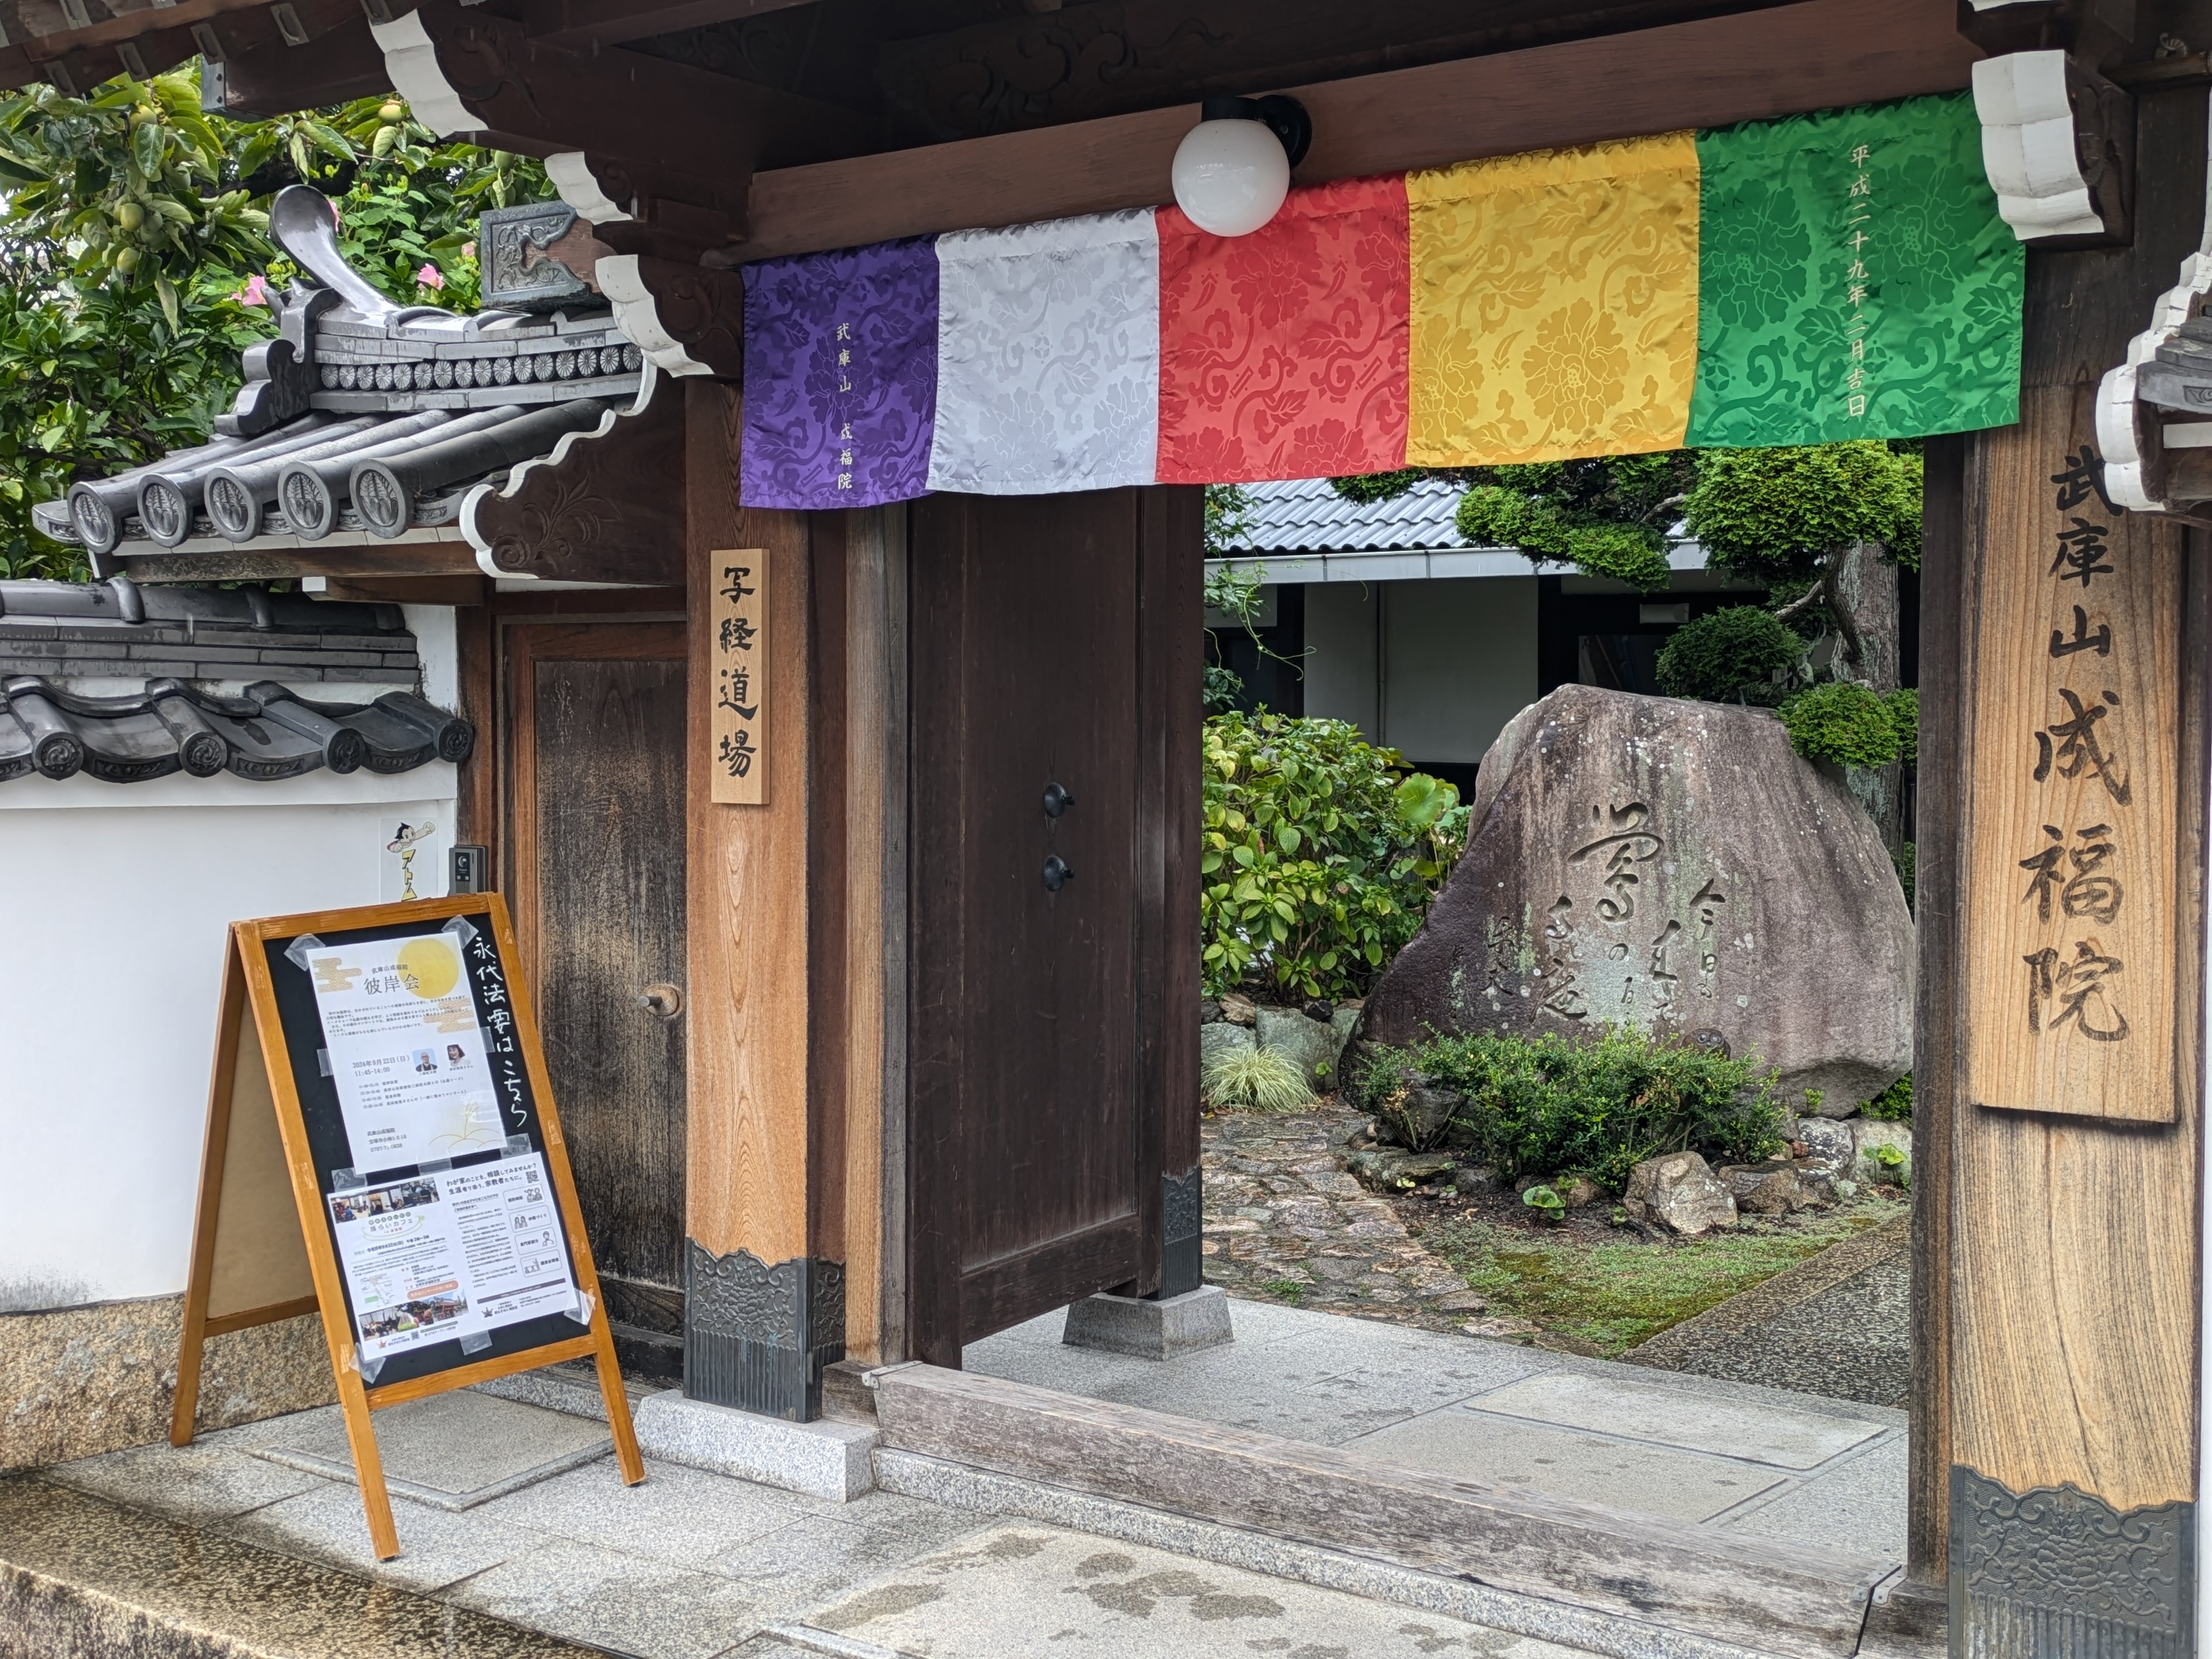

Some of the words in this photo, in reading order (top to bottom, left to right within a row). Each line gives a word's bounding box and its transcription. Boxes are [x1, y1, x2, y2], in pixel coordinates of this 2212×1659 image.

[1847, 144, 1871, 417] 平成二十九年二月吉日
[836, 322, 851, 393] 武庫山
[838, 423, 853, 490] 成福院
[718, 567, 759, 778] 写経道場
[2018, 445, 2131, 1042] 武庫山成福院
[401, 849, 417, 902] アトム
[362, 972, 420, 995] 彼岸会
[473, 937, 526, 1127] 永代法要はこちら
[447, 1163, 536, 1186] わが家のことを、相談してみませんか？
[449, 1176, 522, 1195] 生涯寄り添う、宗教者たちに。
[370, 1218, 413, 1232] 語らいカフェ
